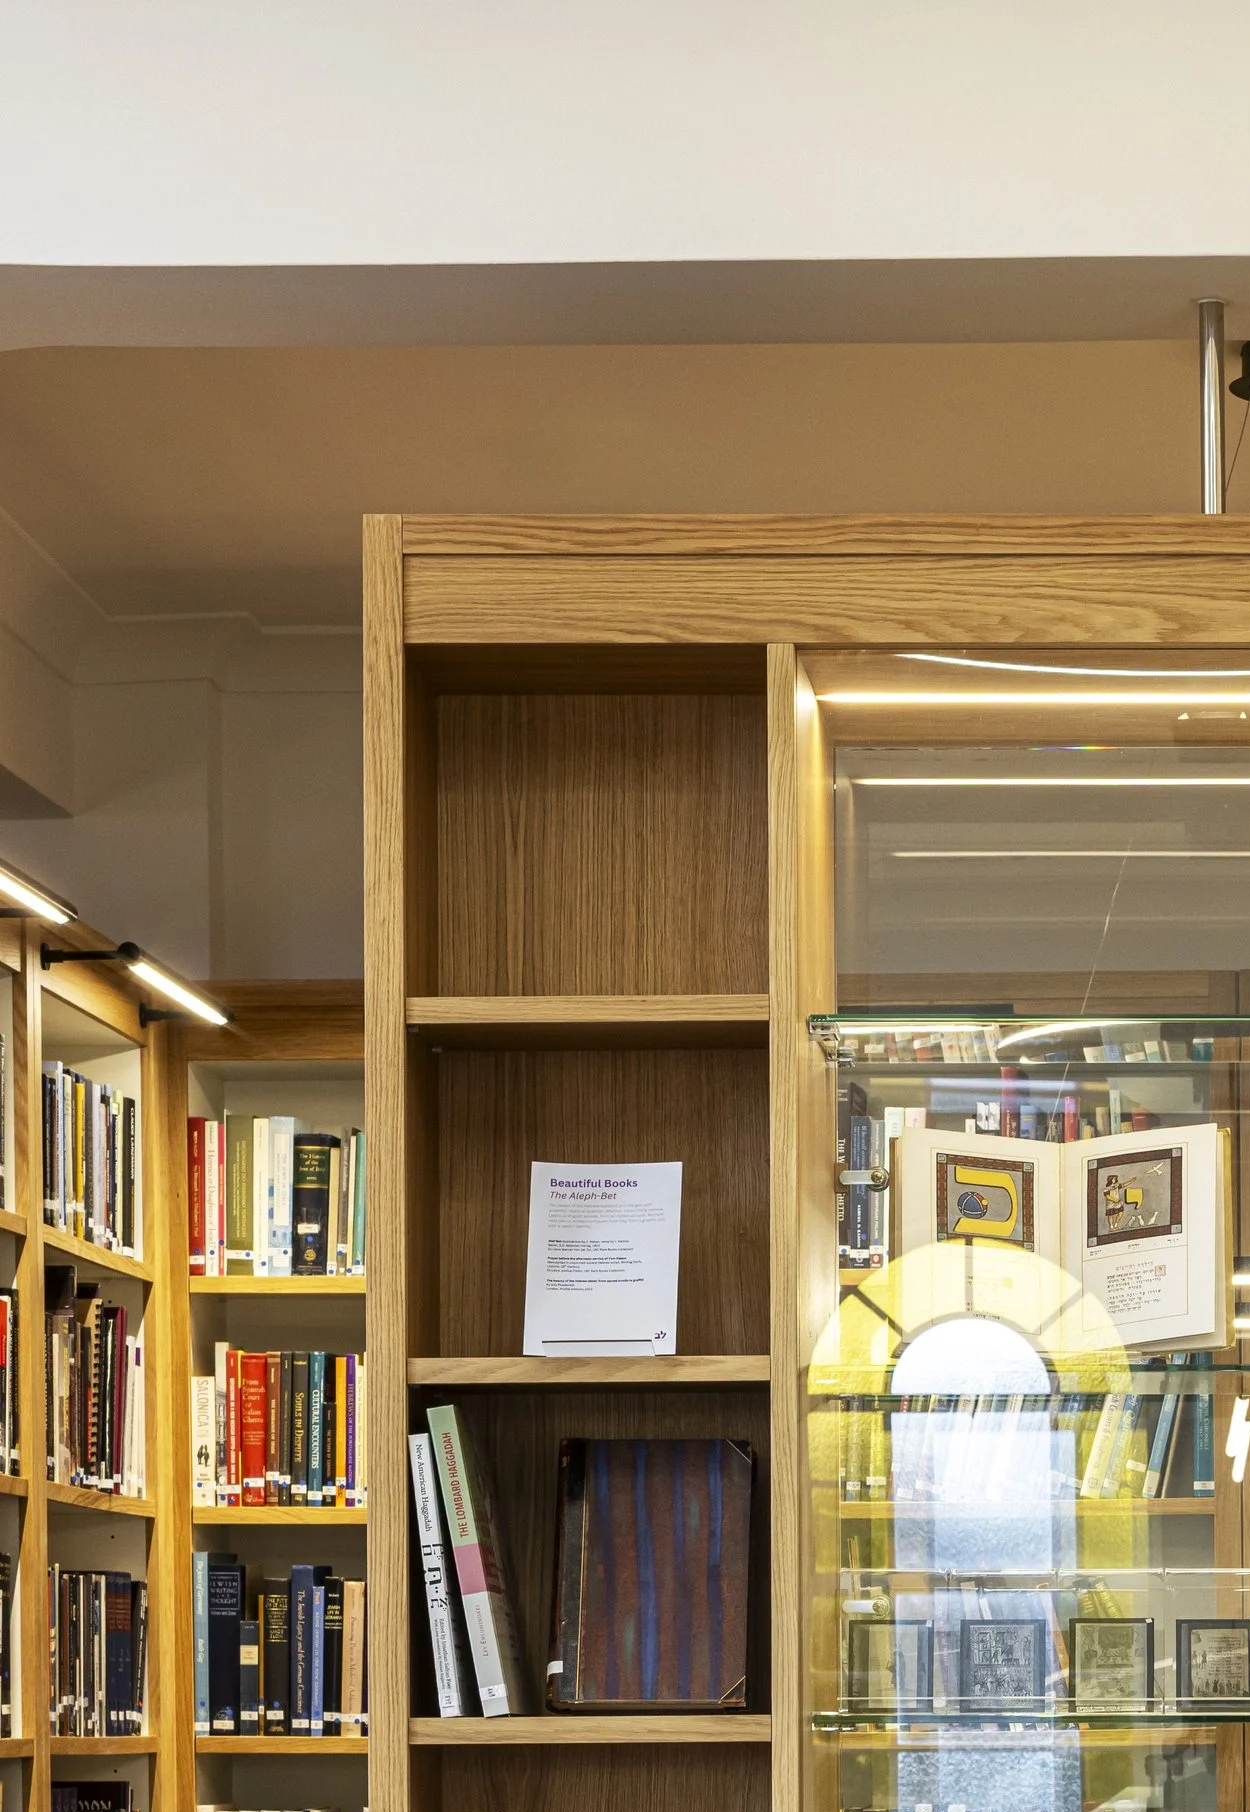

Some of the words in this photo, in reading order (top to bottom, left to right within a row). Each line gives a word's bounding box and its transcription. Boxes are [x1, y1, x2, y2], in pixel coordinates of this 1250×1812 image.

[550, 1178, 601, 1188] Beautiful
[604, 1179, 638, 1188] Books
[550, 1191, 567, 1200] The
[569, 1191, 617, 1201] Aleph-Bet
[415, 1443, 423, 1461] New
[442, 1432, 459, 1480] HAGGADAH
[417, 1461, 428, 1498] American
[452, 1480, 467, 1521] LOMBARD
[421, 1498, 432, 1532] Haggadah
[459, 1521, 470, 1538] THE
